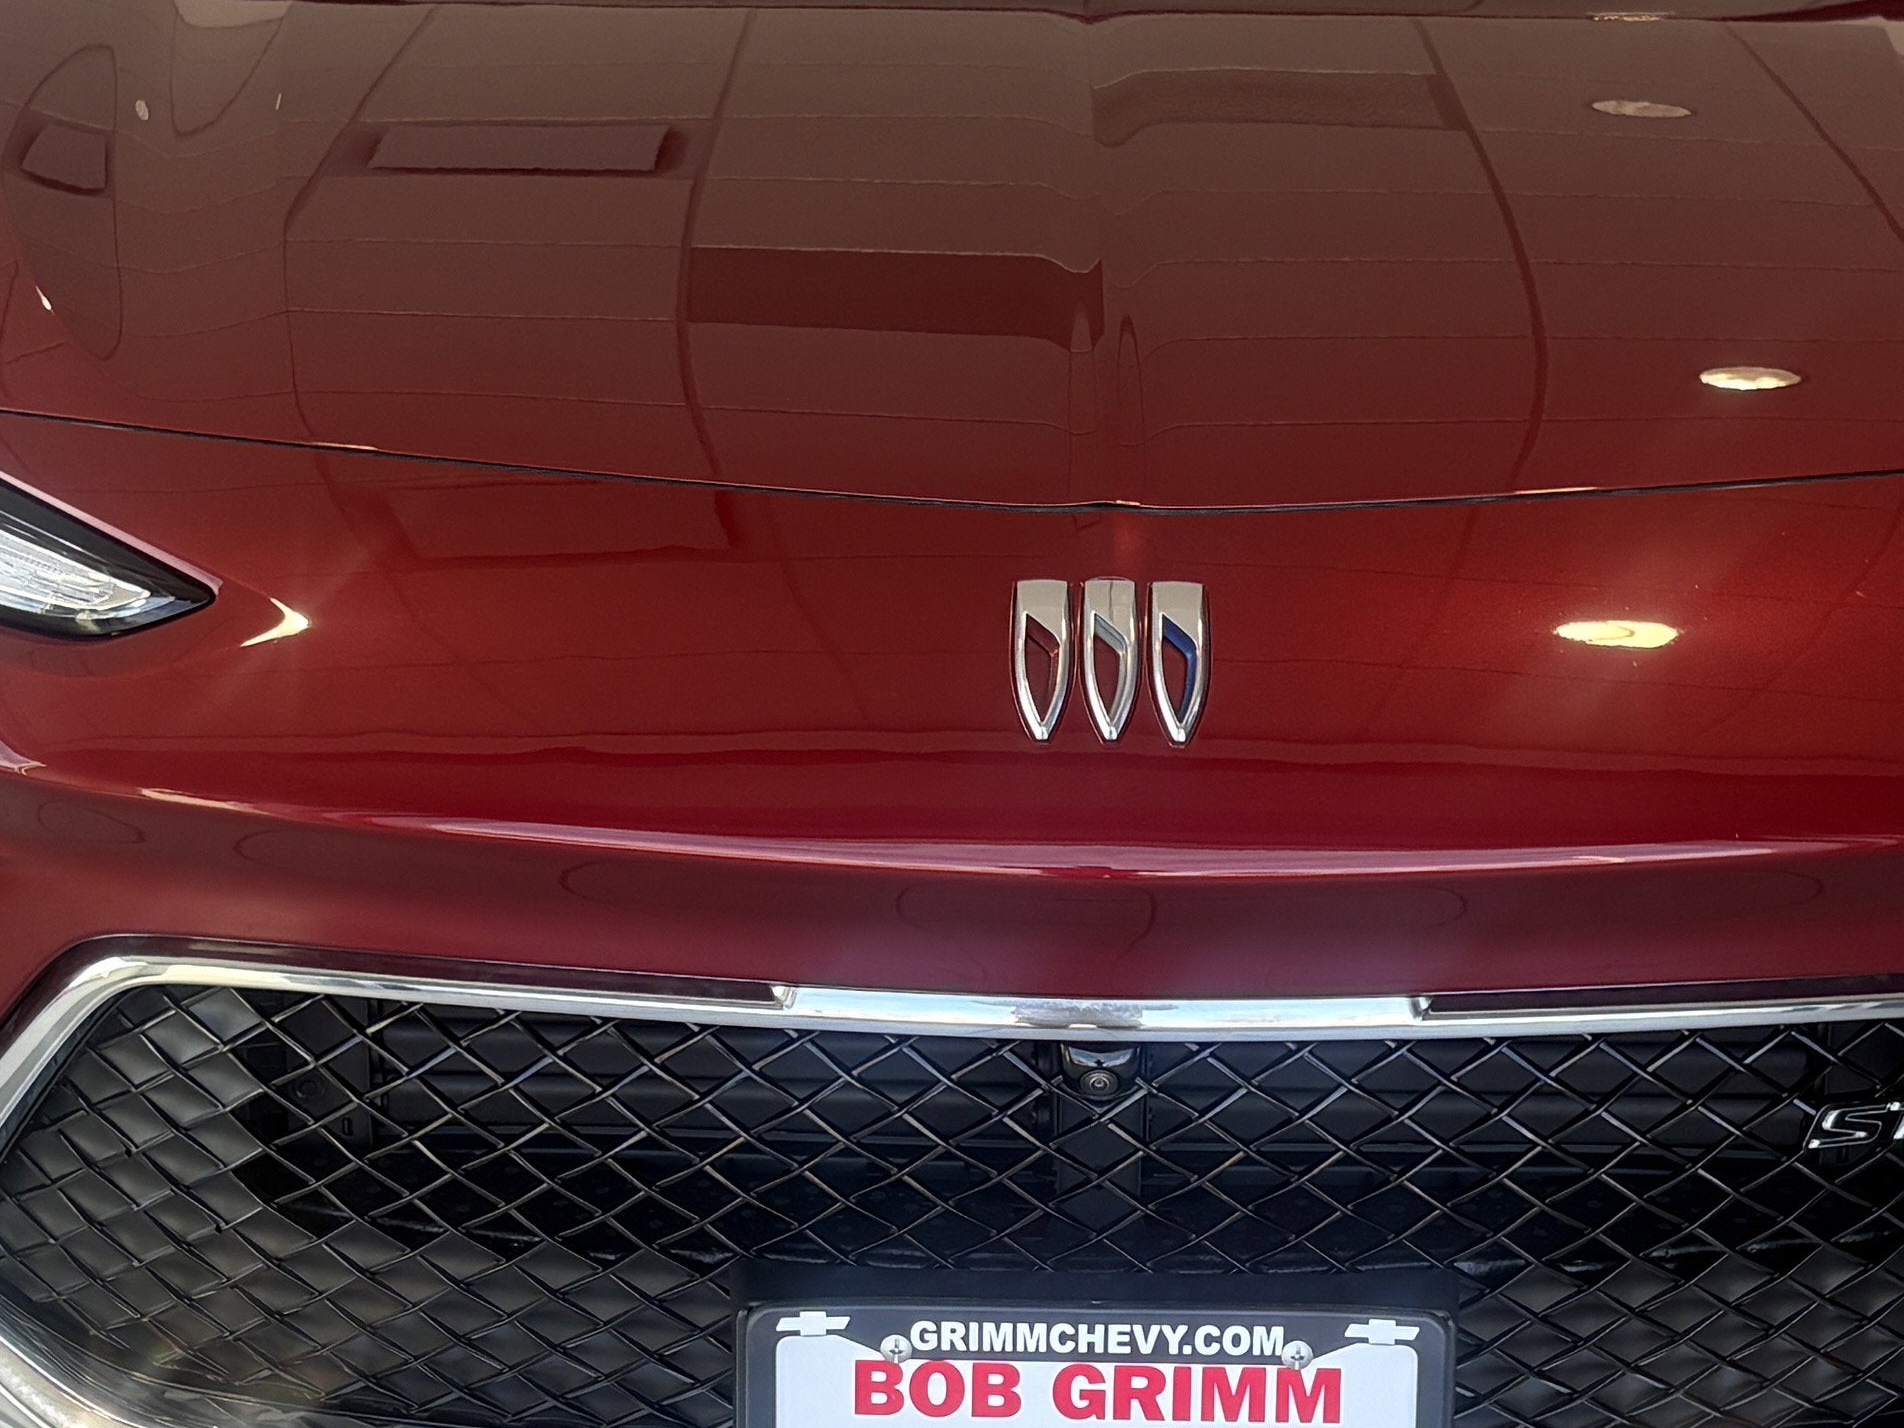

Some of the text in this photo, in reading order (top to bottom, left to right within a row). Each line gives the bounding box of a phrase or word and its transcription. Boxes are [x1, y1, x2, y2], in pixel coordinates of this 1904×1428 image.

[909, 1319, 1286, 1357] GRIMMCHEVY.COM
[854, 1359, 1343, 1425] BOB GRIMM
